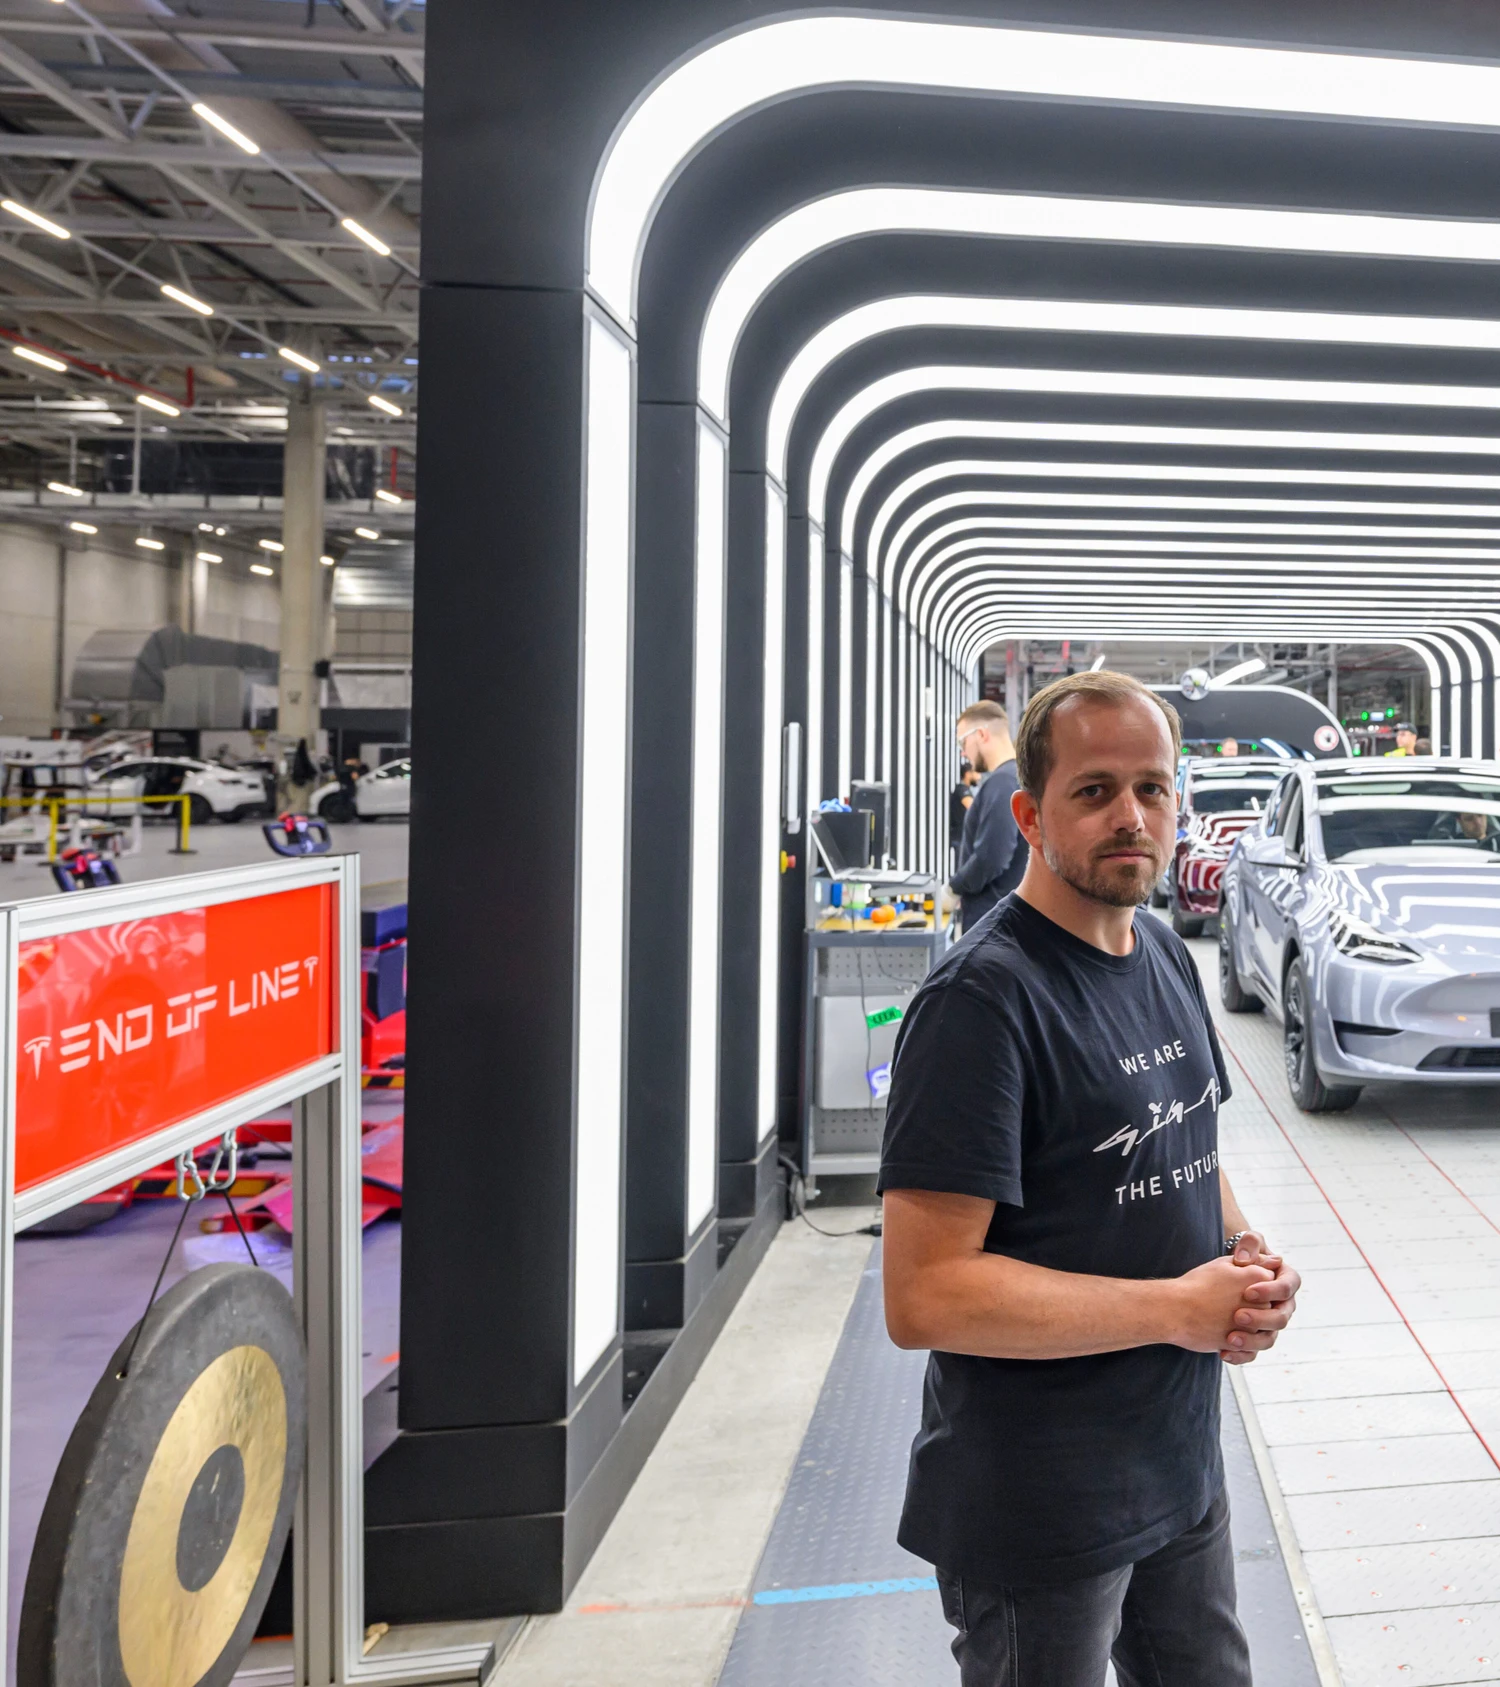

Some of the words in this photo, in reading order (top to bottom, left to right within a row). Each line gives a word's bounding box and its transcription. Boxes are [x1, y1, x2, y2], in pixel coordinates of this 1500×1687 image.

[59, 1003, 153, 1074] END
[166, 984, 218, 1039] OF
[228, 960, 300, 1018] LINE
[1119, 1053, 1150, 1076] WE
[1154, 1040, 1186, 1066] ARE
[1115, 1176, 1163, 1204] THE
[1172, 1150, 1219, 1189] FUTUR
